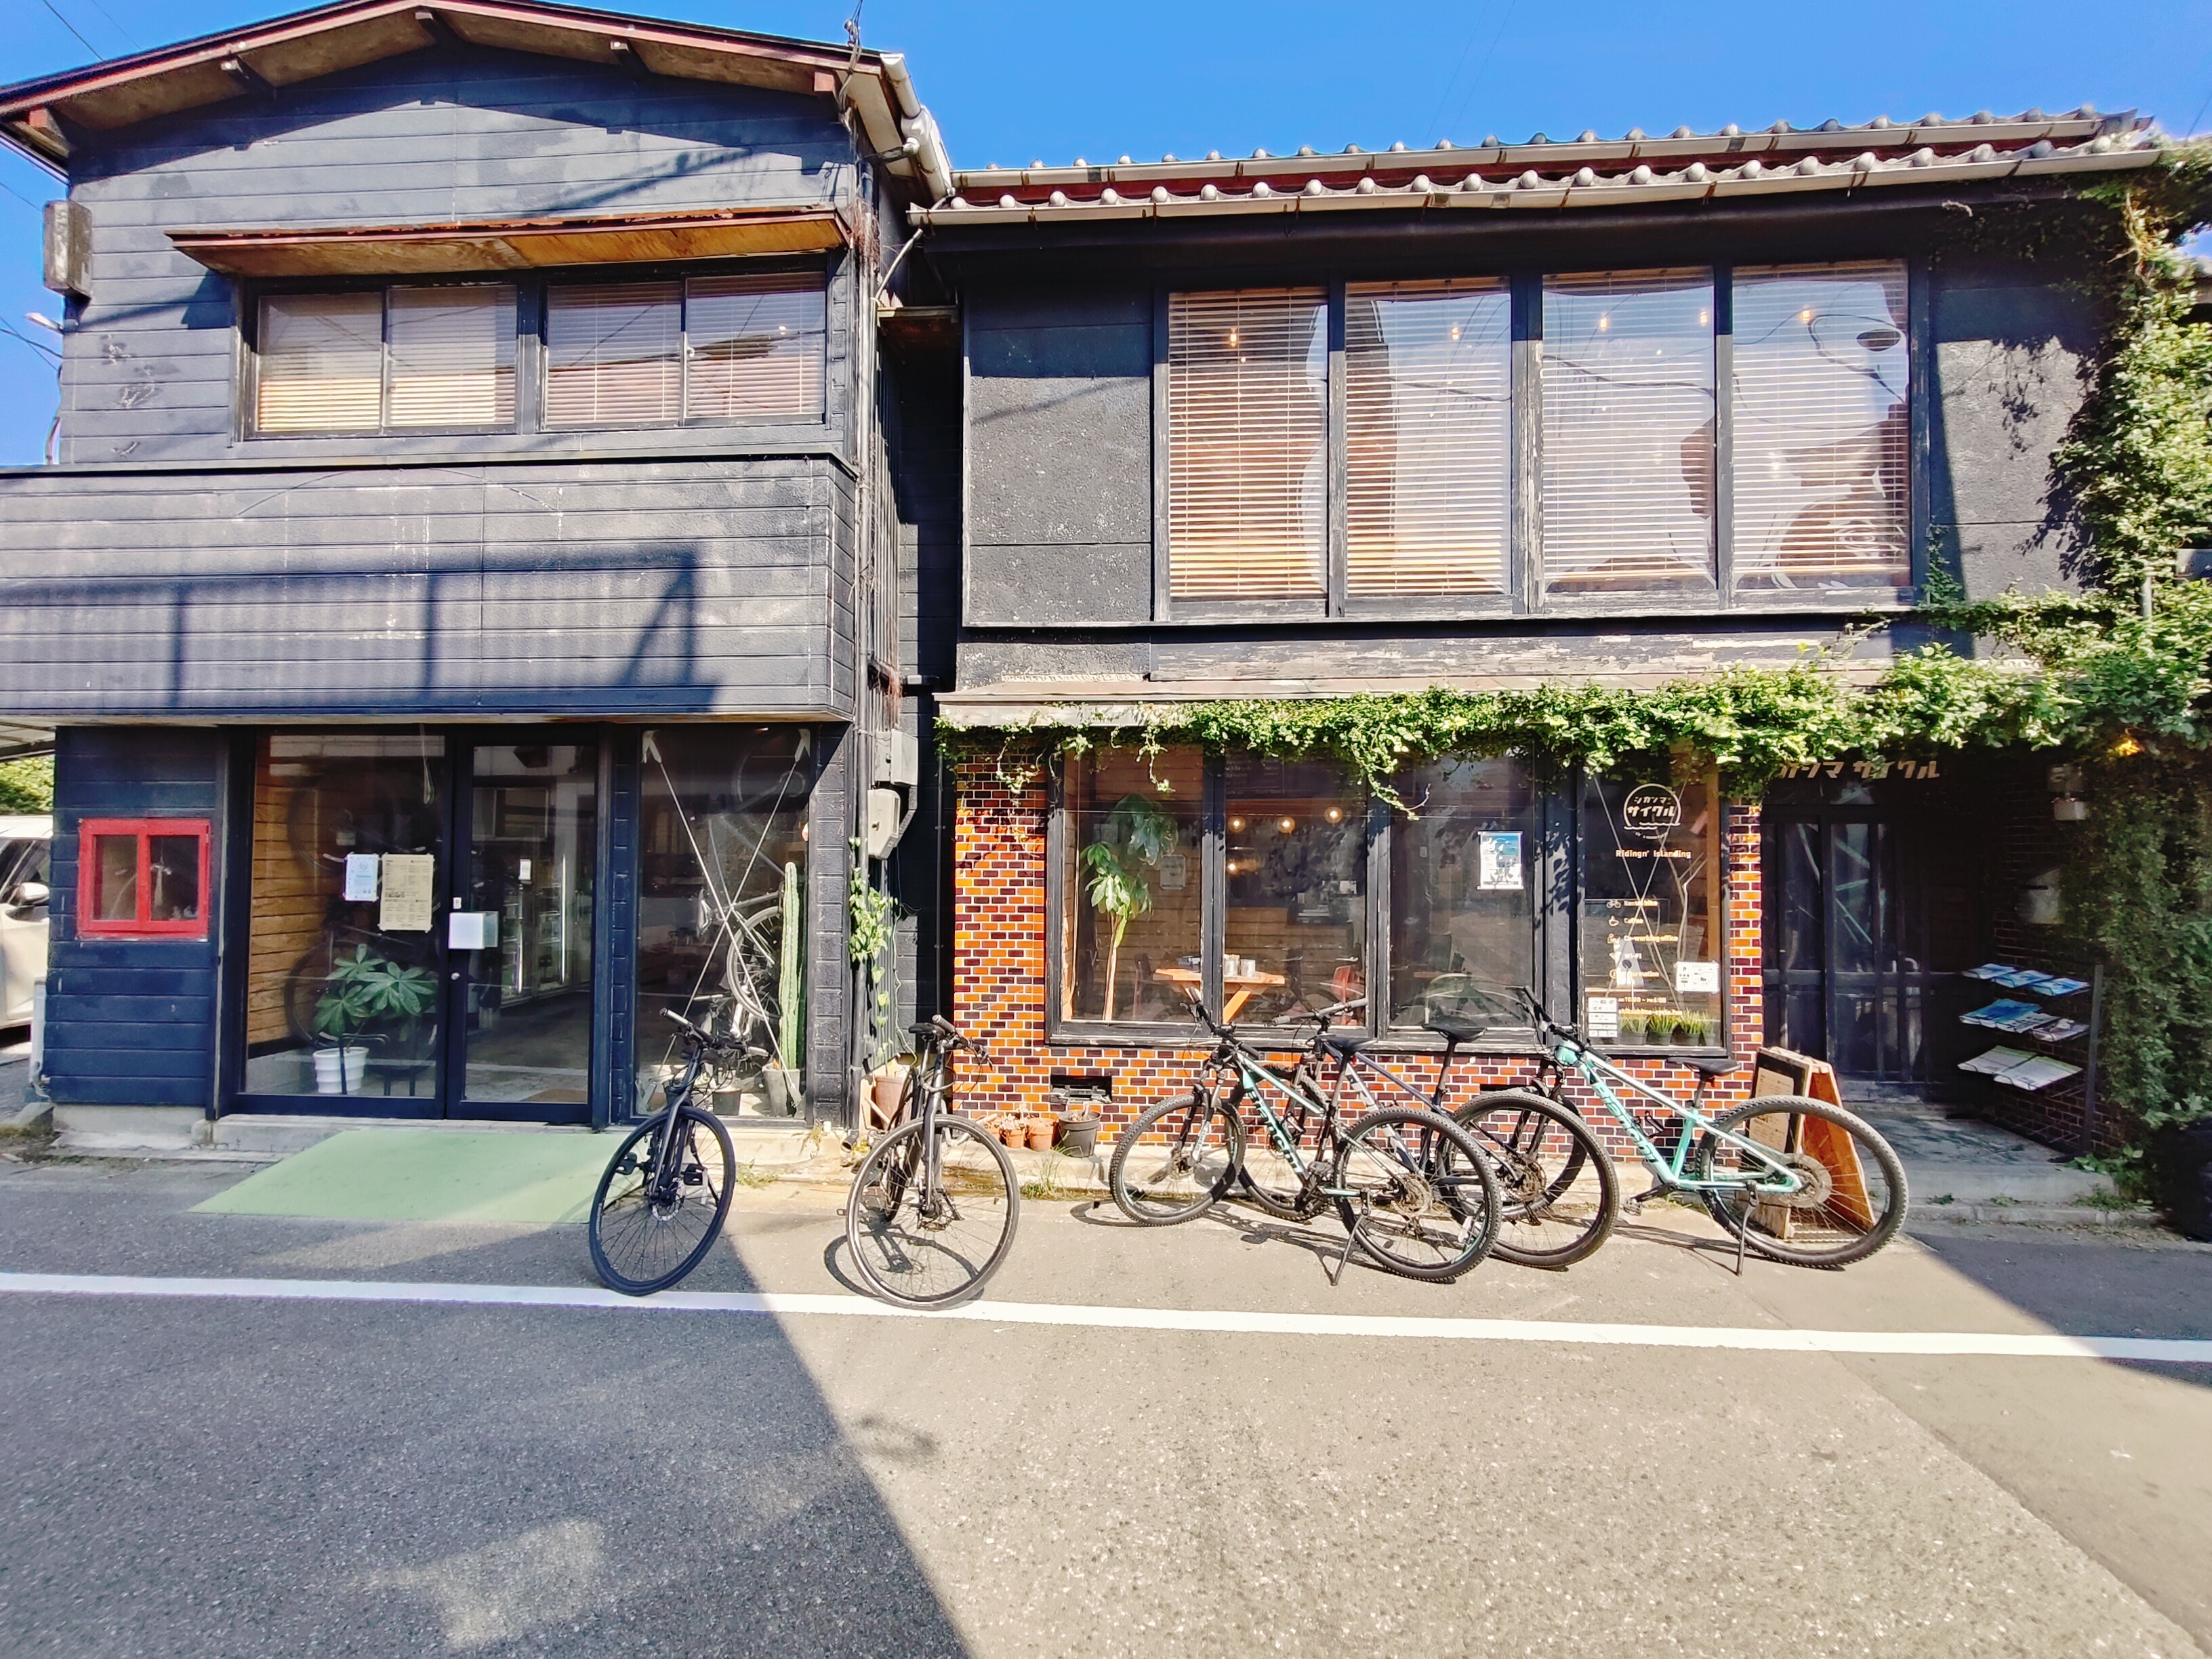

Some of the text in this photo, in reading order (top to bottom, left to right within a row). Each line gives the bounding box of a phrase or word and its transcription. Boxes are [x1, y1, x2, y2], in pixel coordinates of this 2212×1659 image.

[1627, 806, 1675, 817] サイクル
[1654, 849, 1692, 859] Islanding
[1247, 1089, 1298, 1169] Bianchi
[1592, 1083, 1660, 1163] Bianchi
